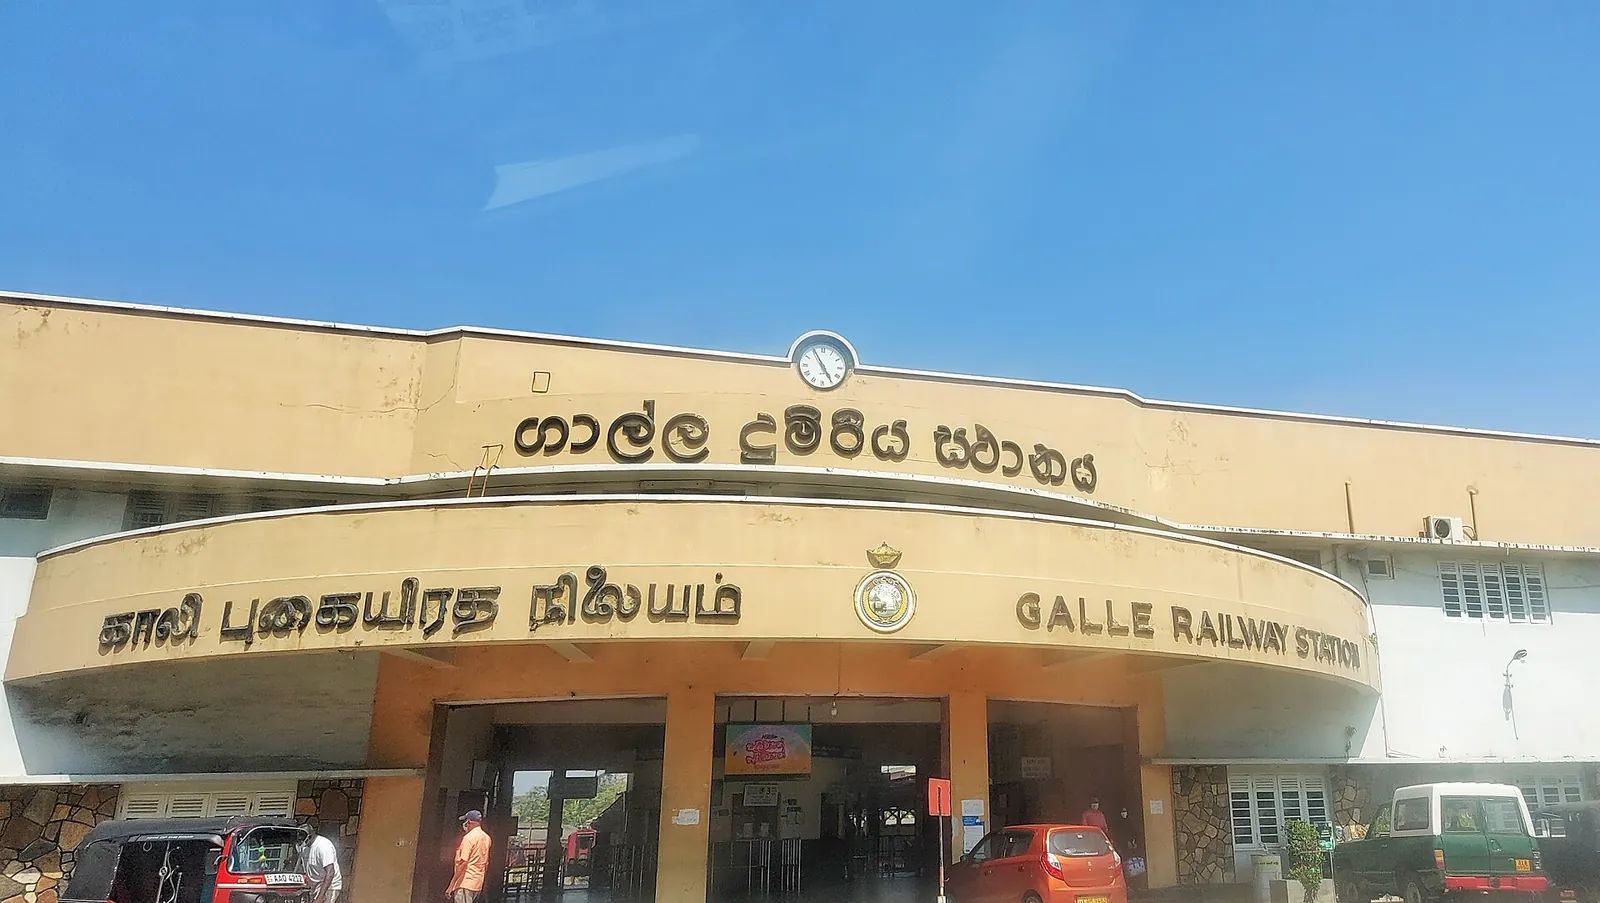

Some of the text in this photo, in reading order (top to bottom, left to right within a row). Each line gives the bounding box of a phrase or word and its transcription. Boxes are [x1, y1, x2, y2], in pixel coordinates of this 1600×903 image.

[514, 399, 710, 464] ගාල්ල
[98, 593, 203, 655] காலி
[529, 565, 741, 632] நிலையம்
[1015, 592, 1361, 669] GALLE RAILWAY STATION
